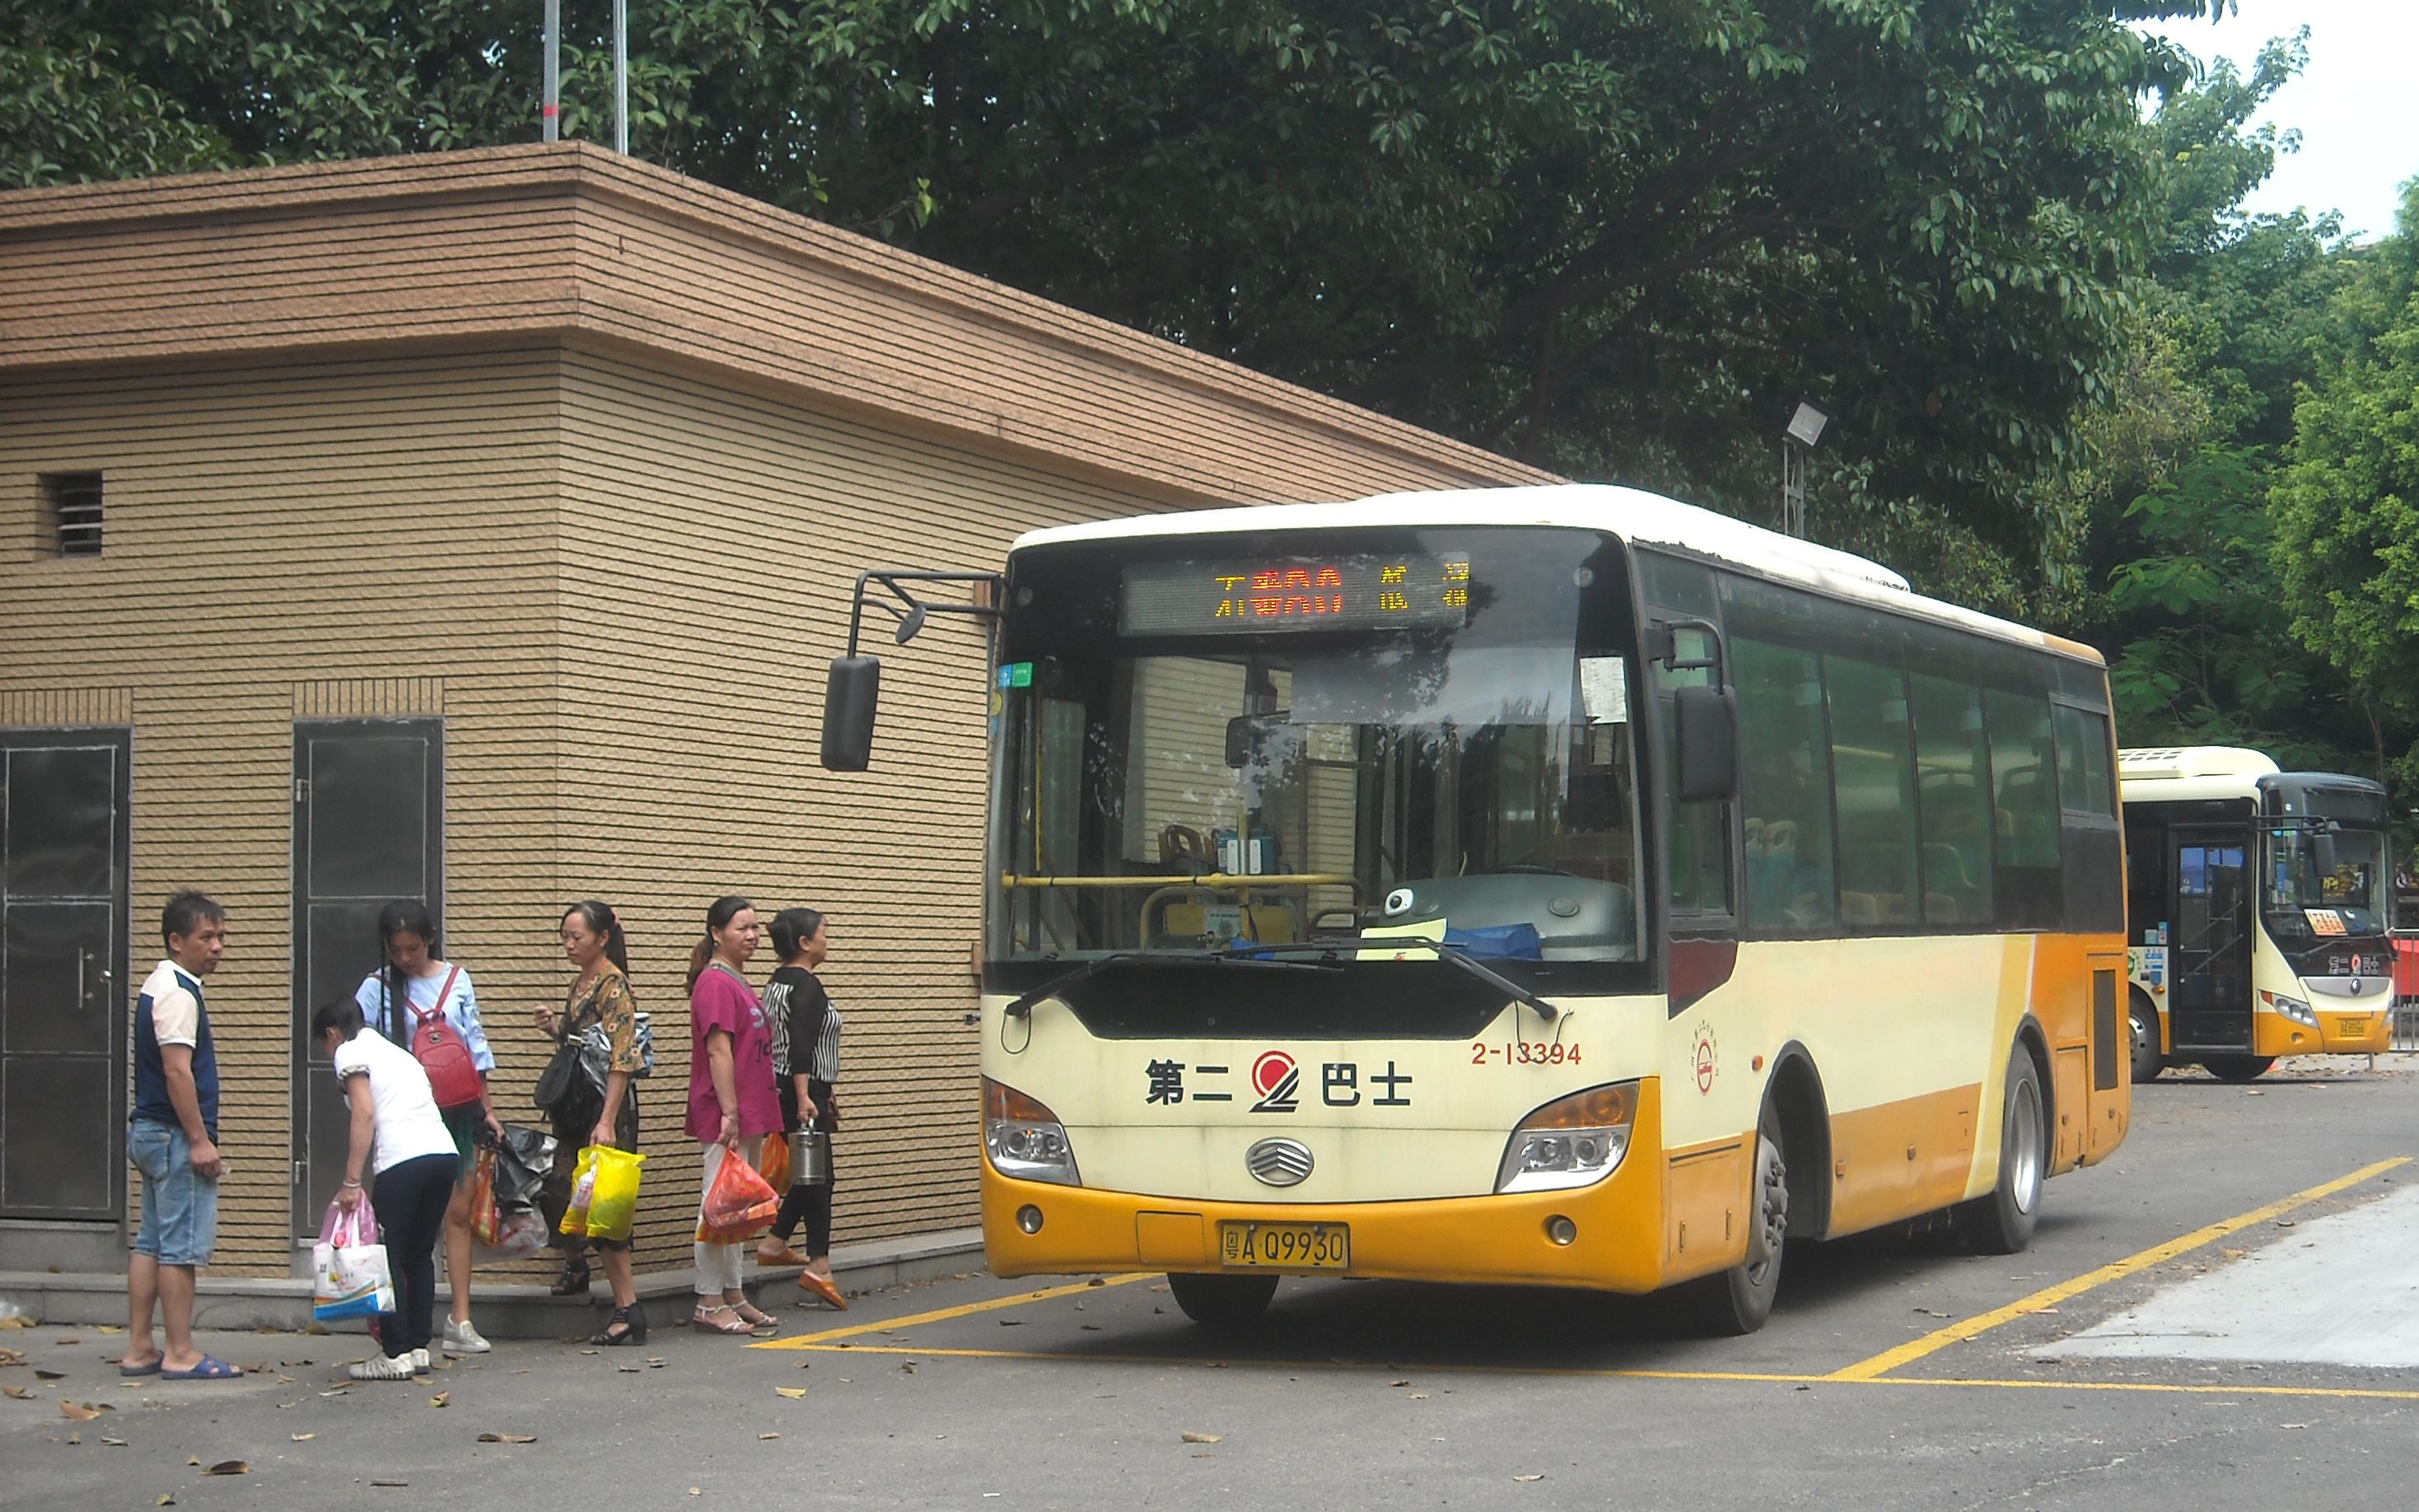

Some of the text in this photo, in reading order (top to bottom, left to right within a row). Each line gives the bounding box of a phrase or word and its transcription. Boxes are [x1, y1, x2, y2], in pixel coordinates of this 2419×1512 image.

[1471, 1041, 1582, 1066] 2-13394
[1145, 1058, 1233, 1105] 第二
[1322, 1060, 1413, 1107] 巴士
